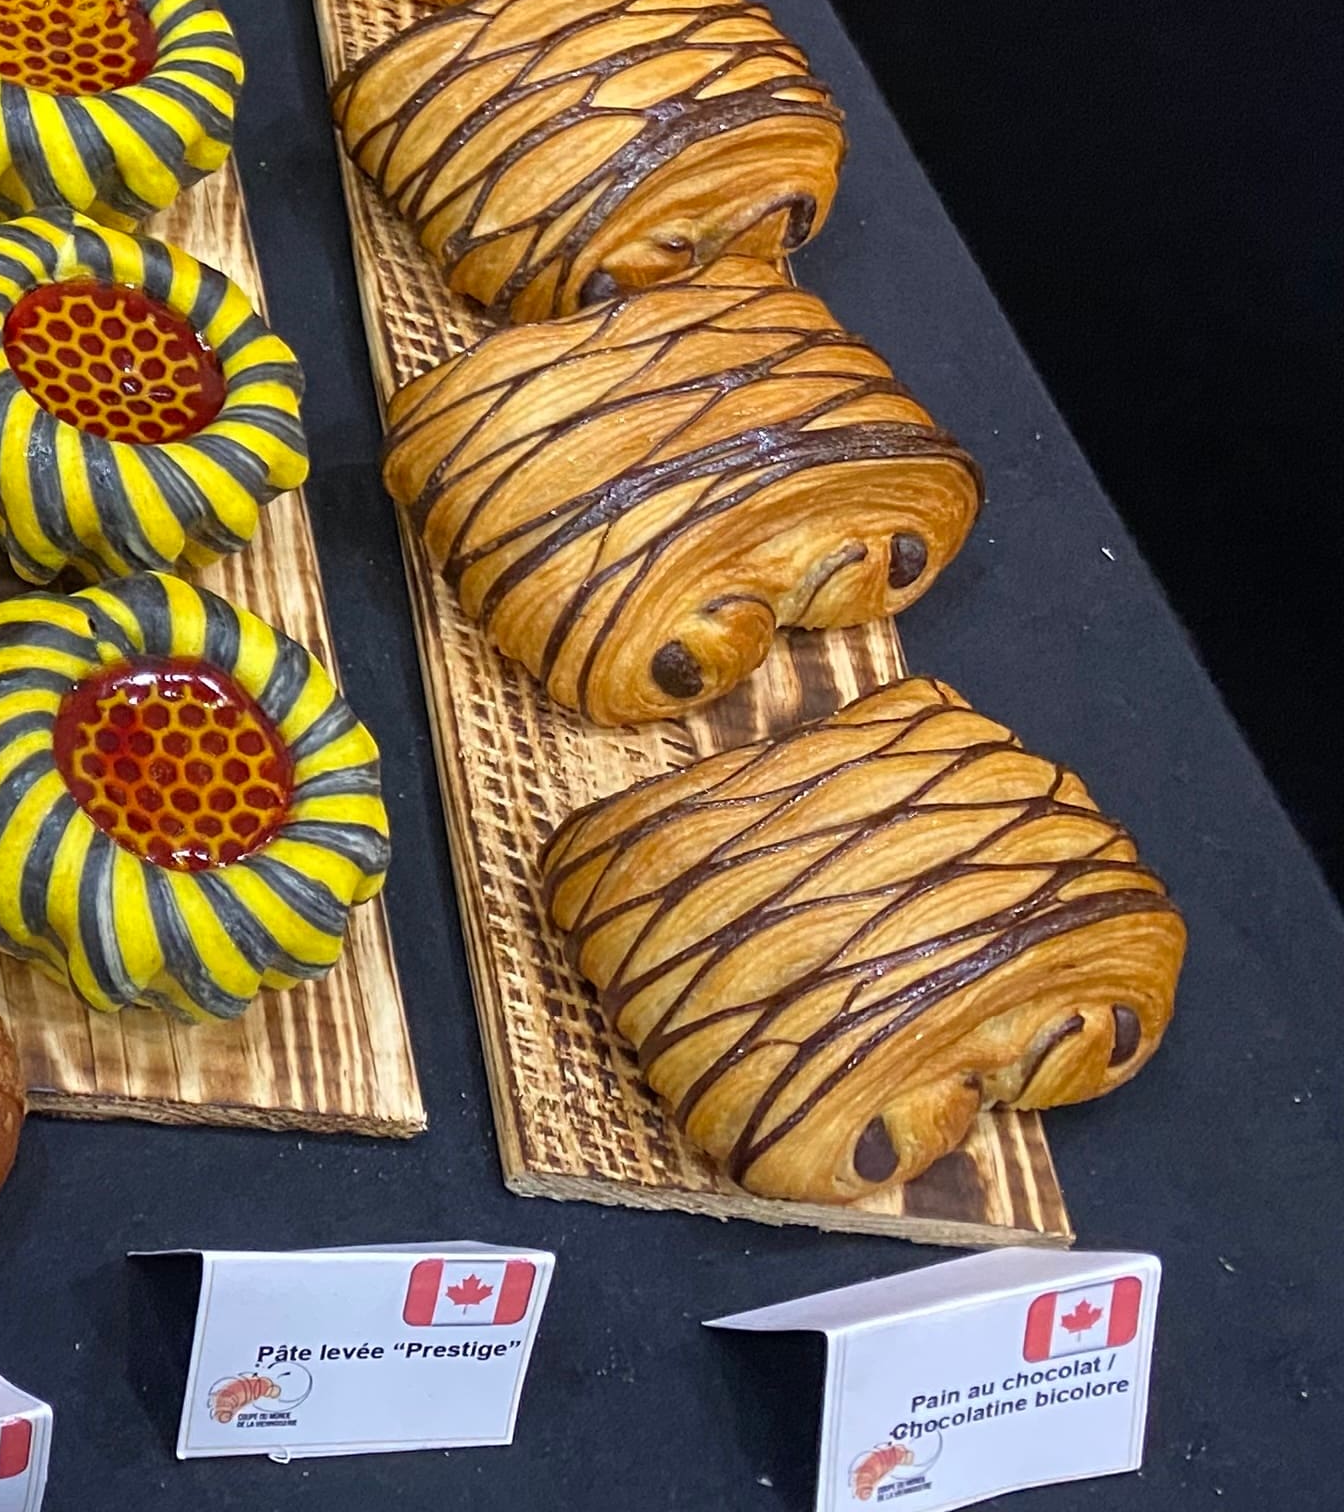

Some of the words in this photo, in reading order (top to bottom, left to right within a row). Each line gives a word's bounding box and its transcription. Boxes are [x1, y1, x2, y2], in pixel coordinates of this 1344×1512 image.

[256, 1344, 312, 1363] Pâte
[319, 1342, 384, 1360] levée
[892, 1396, 1028, 1441] Chocolatine
[1035, 1378, 1130, 1407] bicolore
[911, 1389, 961, 1413] Pain
[968, 1382, 995, 1401] au
[1002, 1358, 1102, 1392] chocolat
